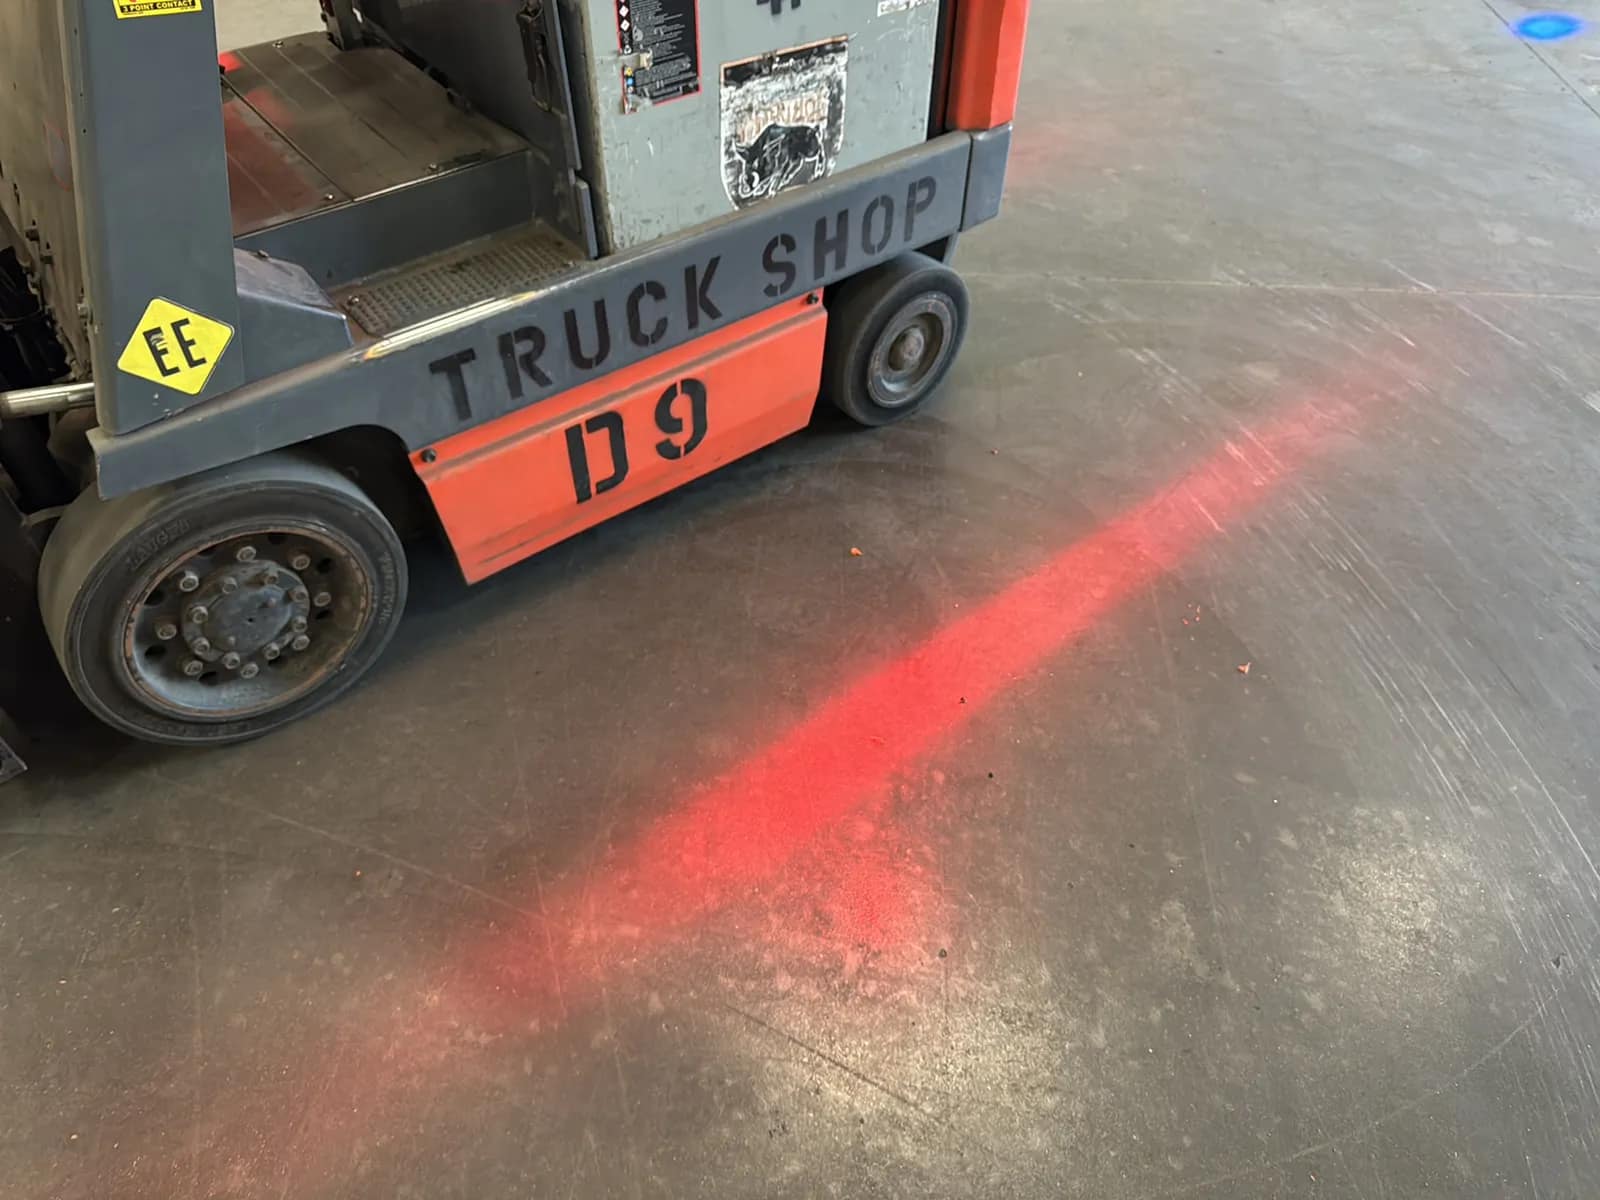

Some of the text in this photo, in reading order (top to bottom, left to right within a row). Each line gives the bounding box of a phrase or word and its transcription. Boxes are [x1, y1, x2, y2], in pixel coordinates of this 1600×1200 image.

[130, 3, 155, 12] POINT
[156, 0, 193, 9] CONTACT
[429, 176, 937, 421] TRUCK SHOP
[143, 318, 207, 377] EE
[564, 378, 708, 504] D9
